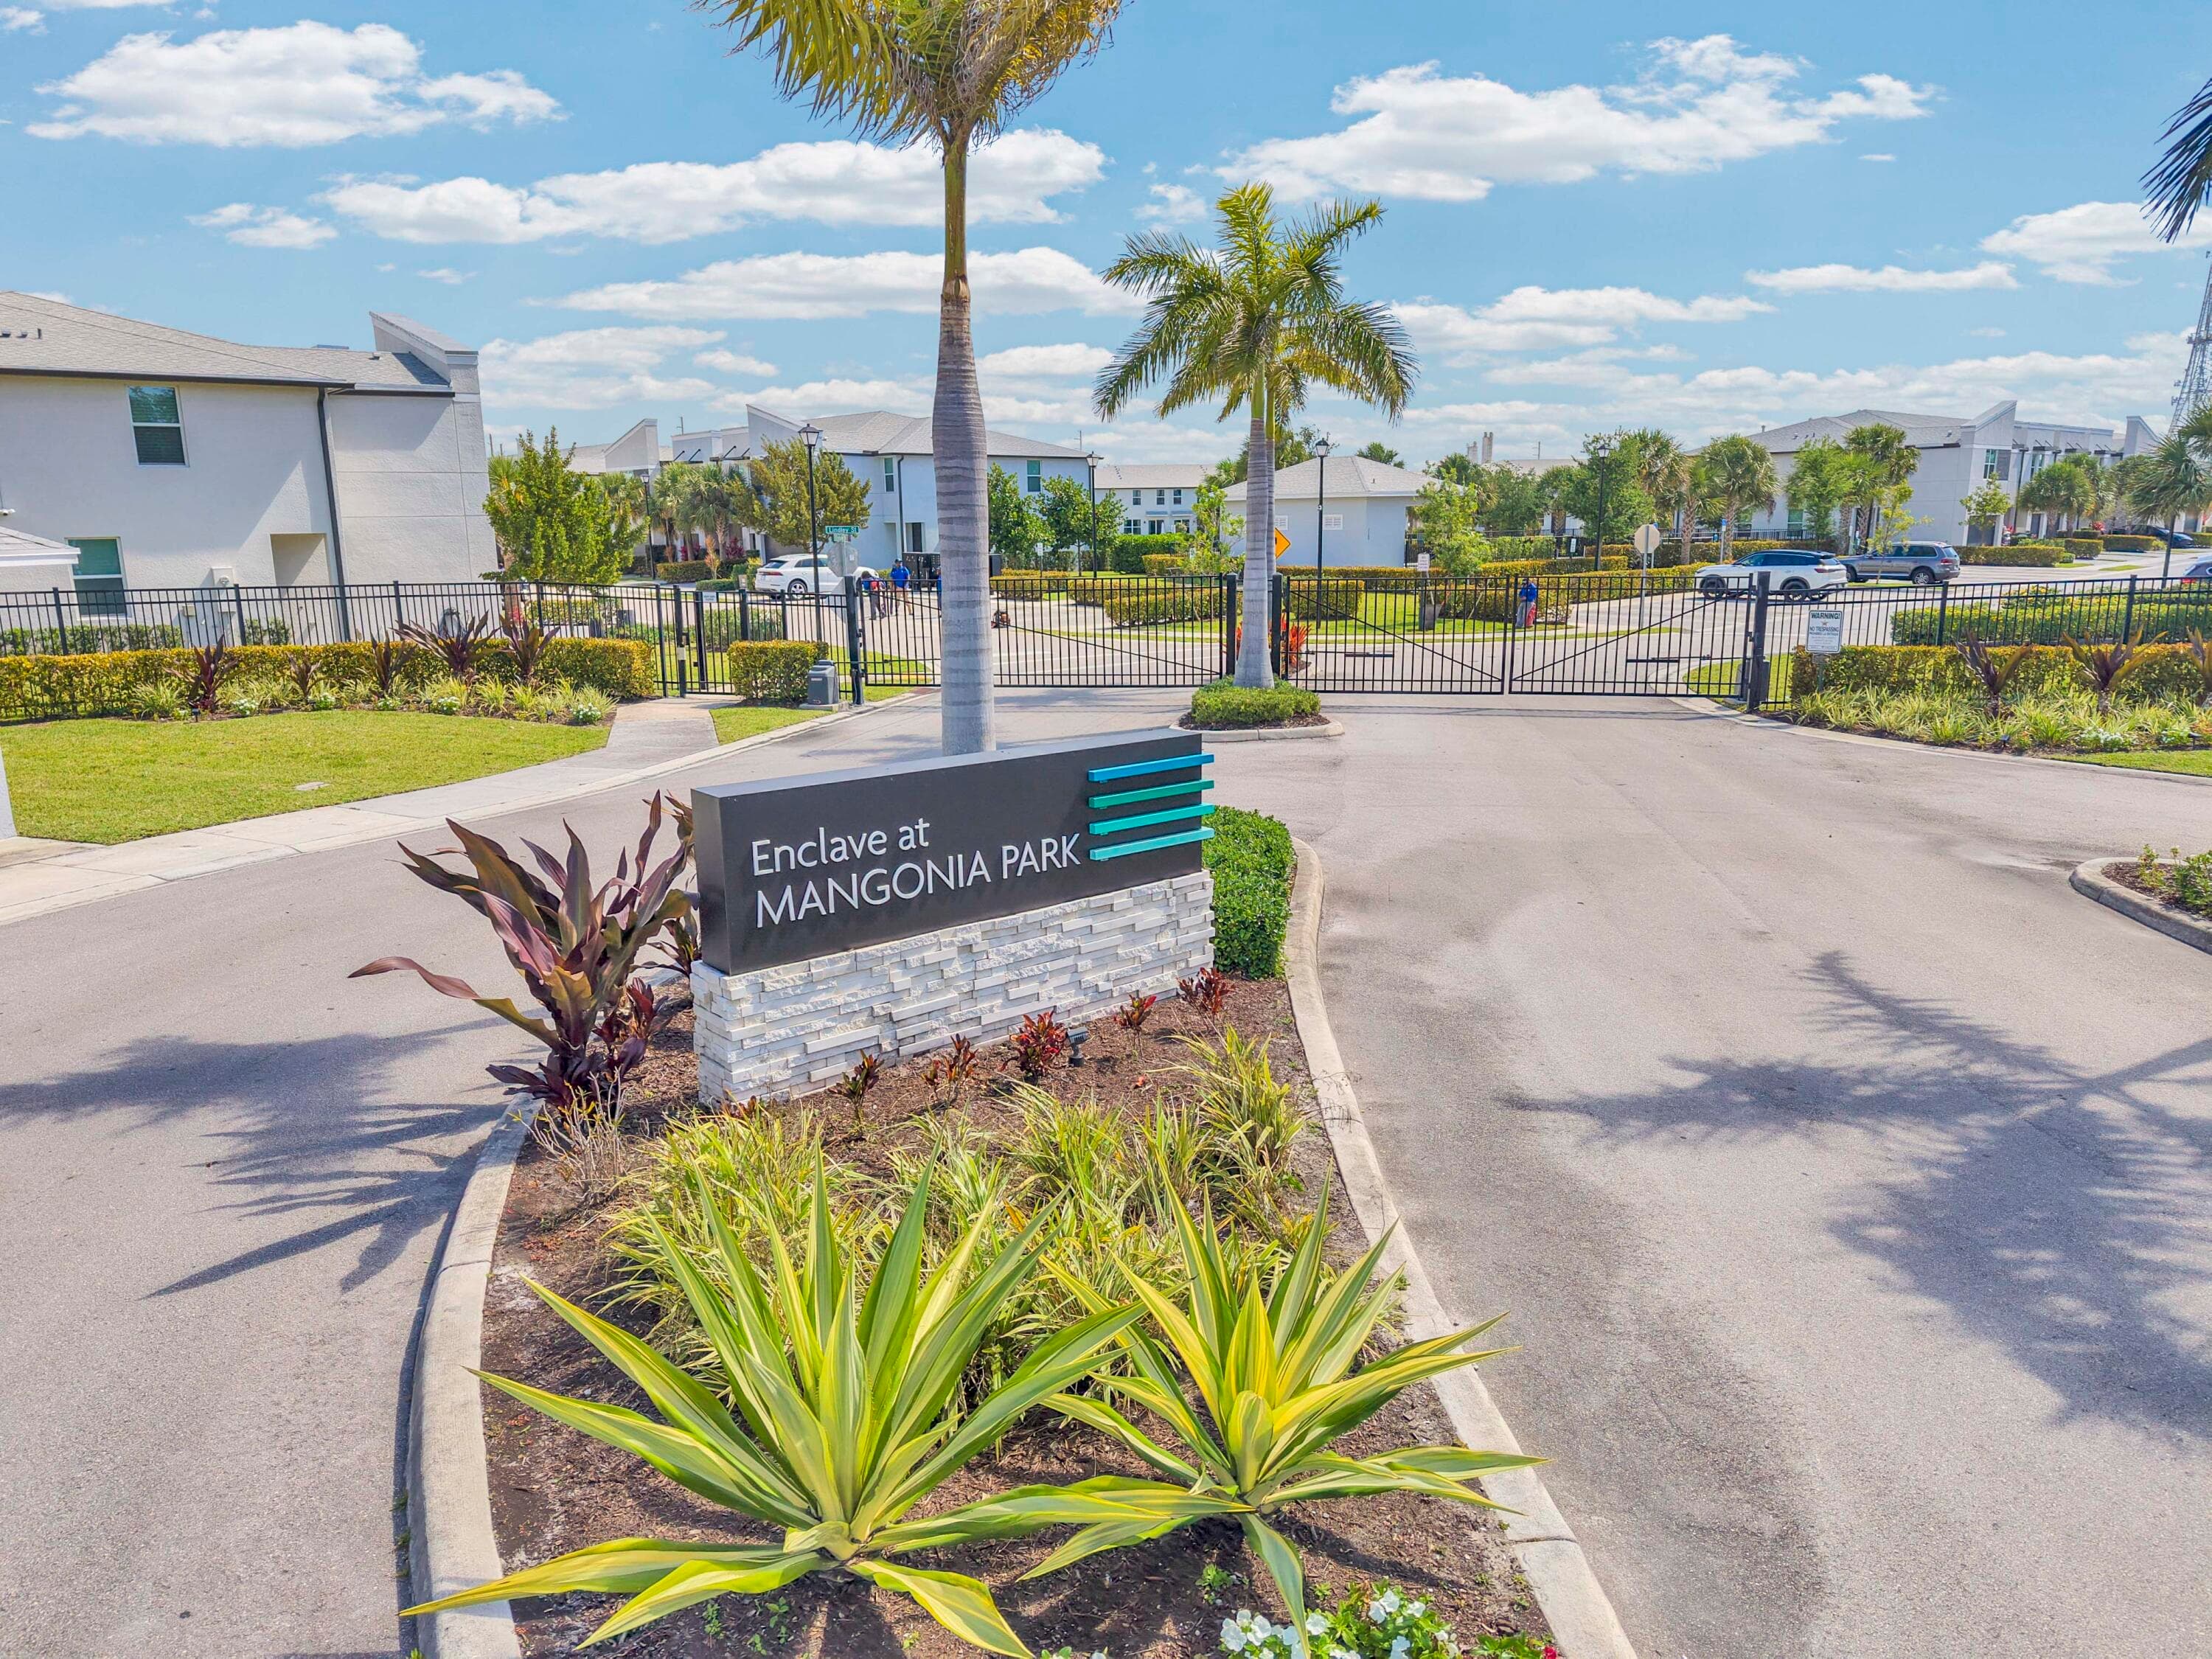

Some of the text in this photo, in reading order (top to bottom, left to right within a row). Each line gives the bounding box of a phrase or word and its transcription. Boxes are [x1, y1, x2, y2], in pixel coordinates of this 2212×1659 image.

[752, 818, 930, 876] Enclave at
[757, 833, 1082, 928] MANGONIA PARK
